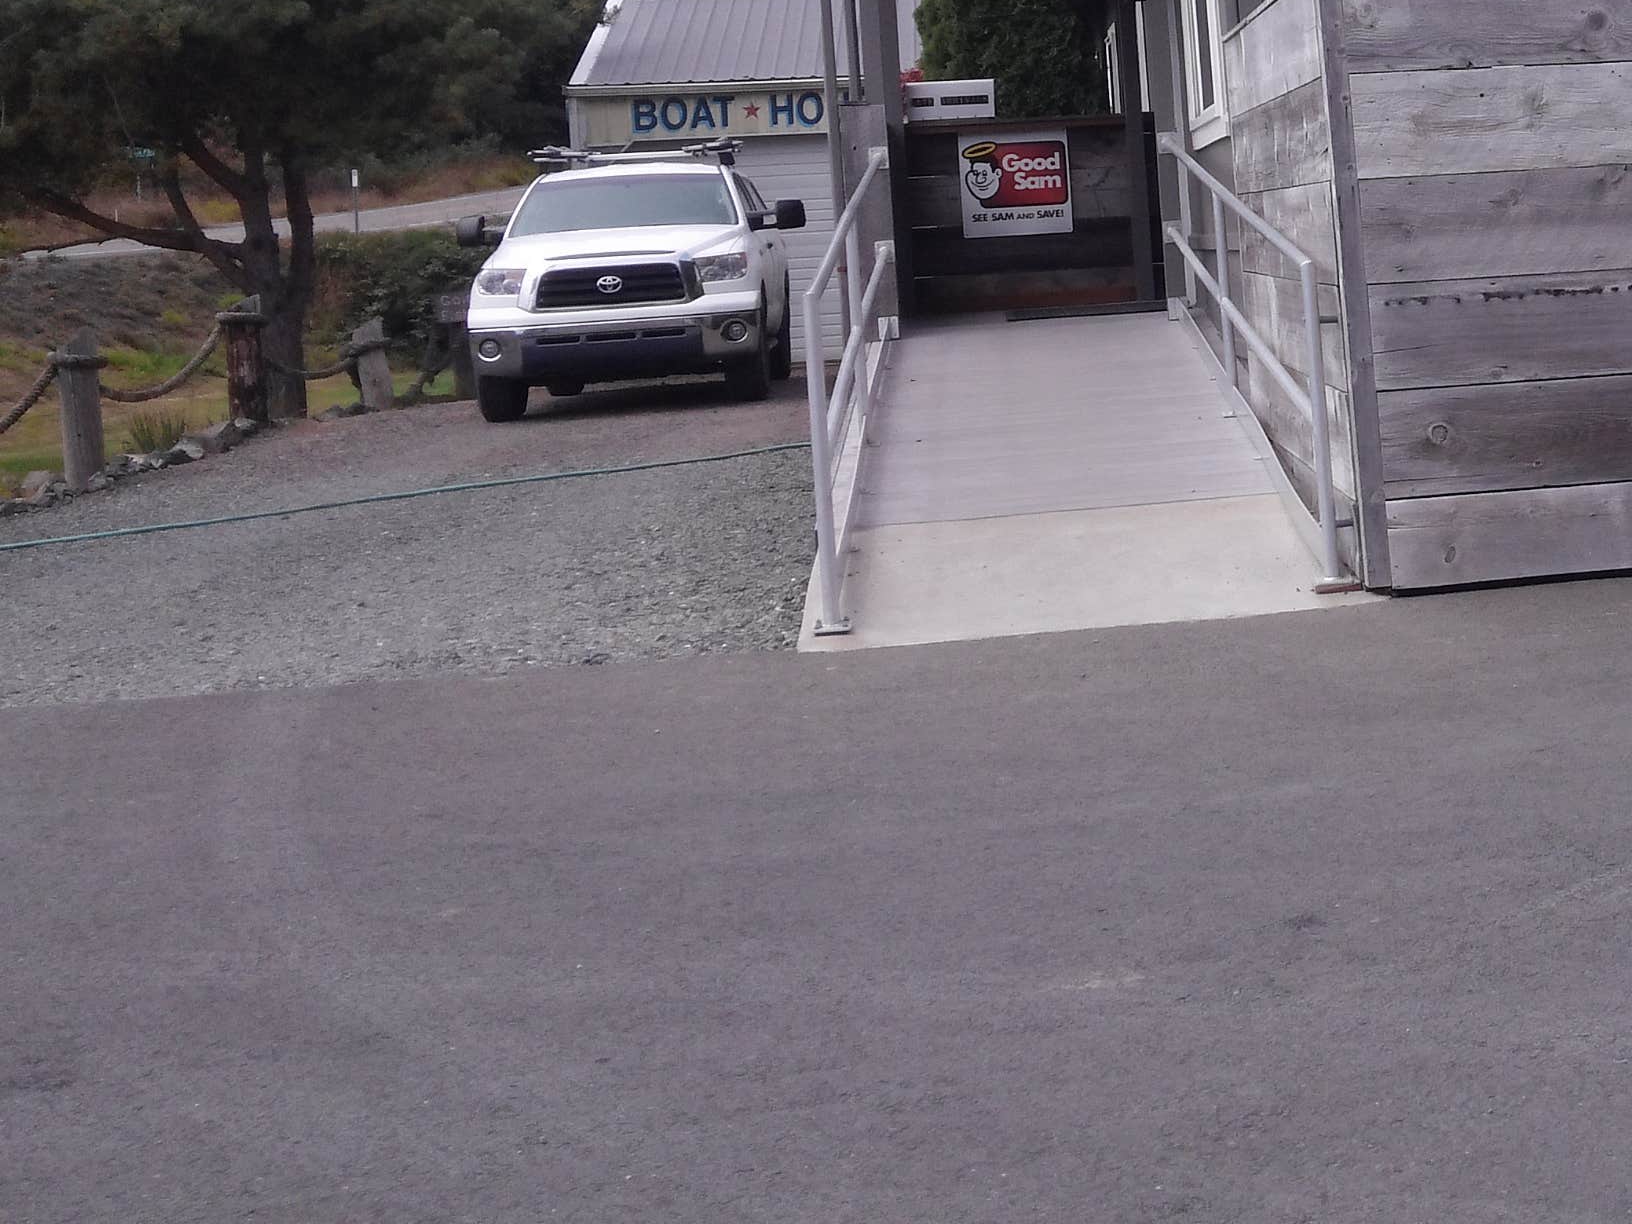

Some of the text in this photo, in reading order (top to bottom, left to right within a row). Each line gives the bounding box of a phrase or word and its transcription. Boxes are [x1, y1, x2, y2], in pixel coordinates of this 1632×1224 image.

[631, 95, 736, 132] BOAT
[1002, 151, 1061, 172] Good
[1014, 172, 1063, 191] Sam
[972, 212, 989, 223] SEE
[991, 211, 1015, 222] SAM
[1036, 207, 1065, 219] SAVE!
